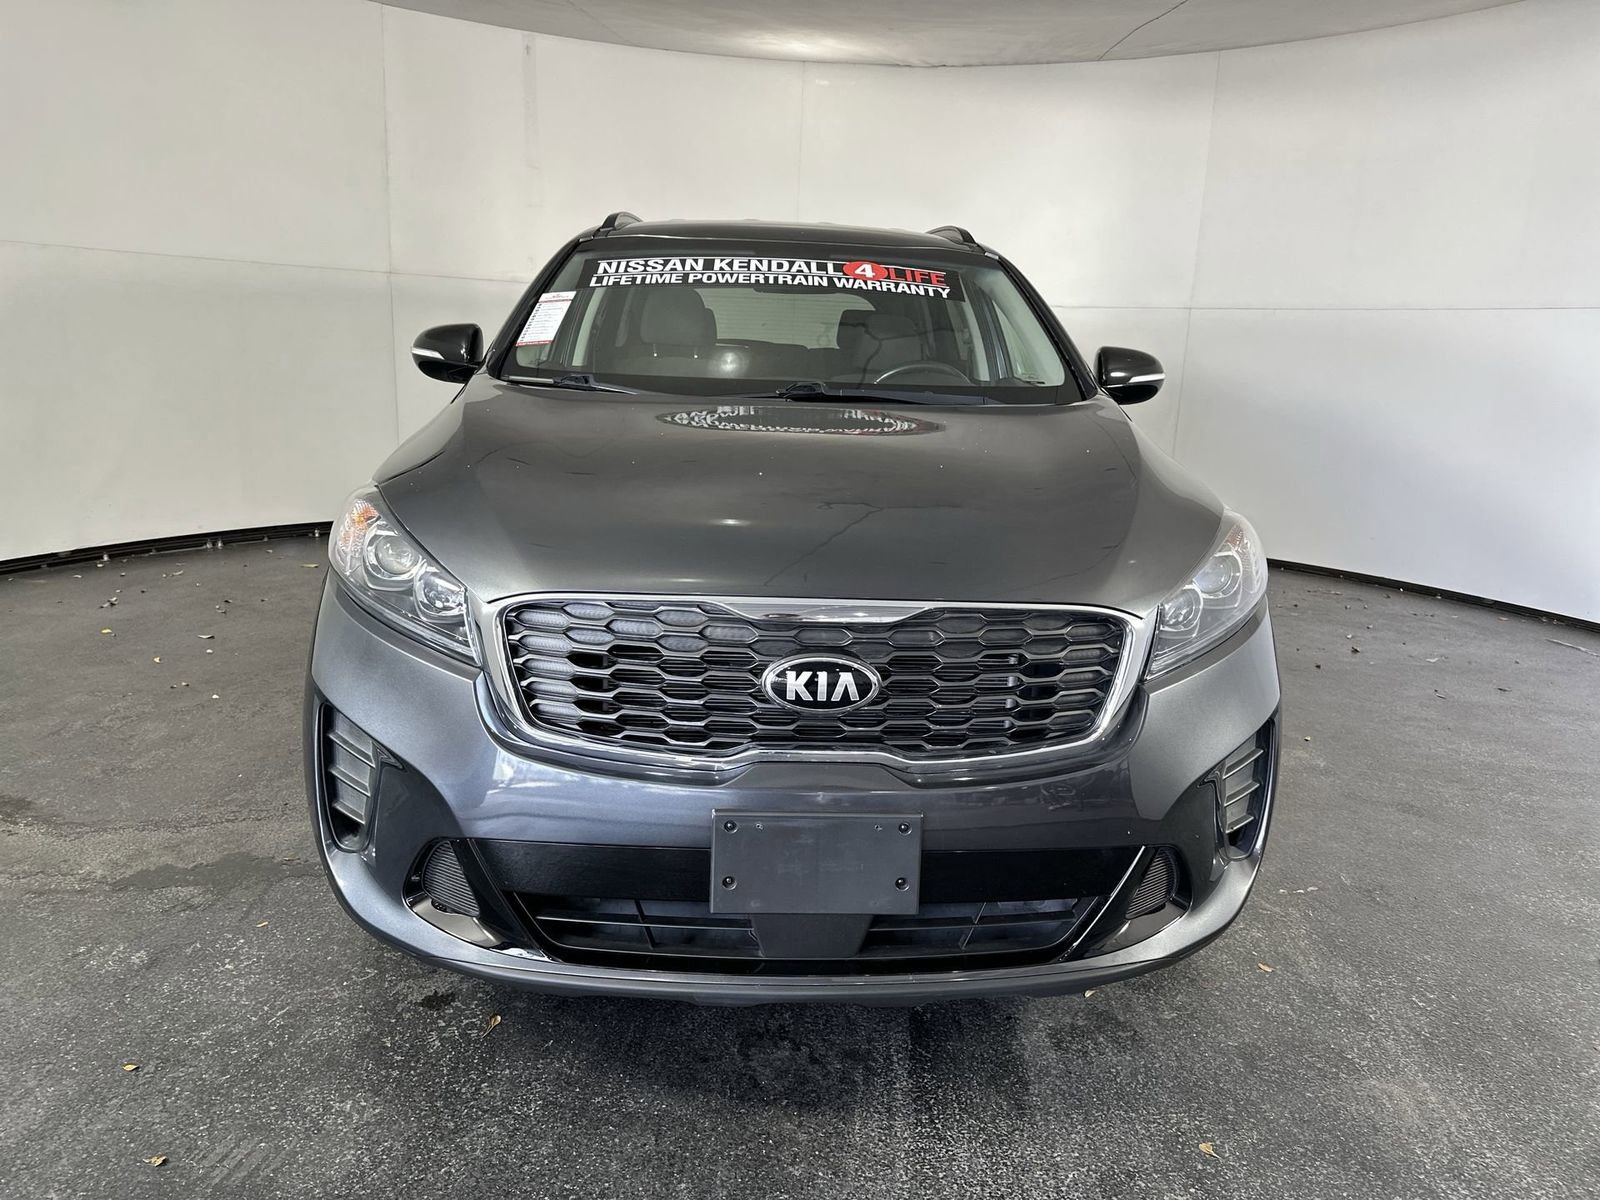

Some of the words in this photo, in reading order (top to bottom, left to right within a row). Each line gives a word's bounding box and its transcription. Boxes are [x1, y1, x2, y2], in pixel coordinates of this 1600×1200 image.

[597, 259, 704, 274] NISSAN
[714, 258, 844, 275] KENDALL
[589, 274, 683, 287] LIFETIME
[688, 273, 828, 287] POWERTRAIN
[832, 277, 951, 299] WARRANTY
[785, 670, 860, 702] KIA
